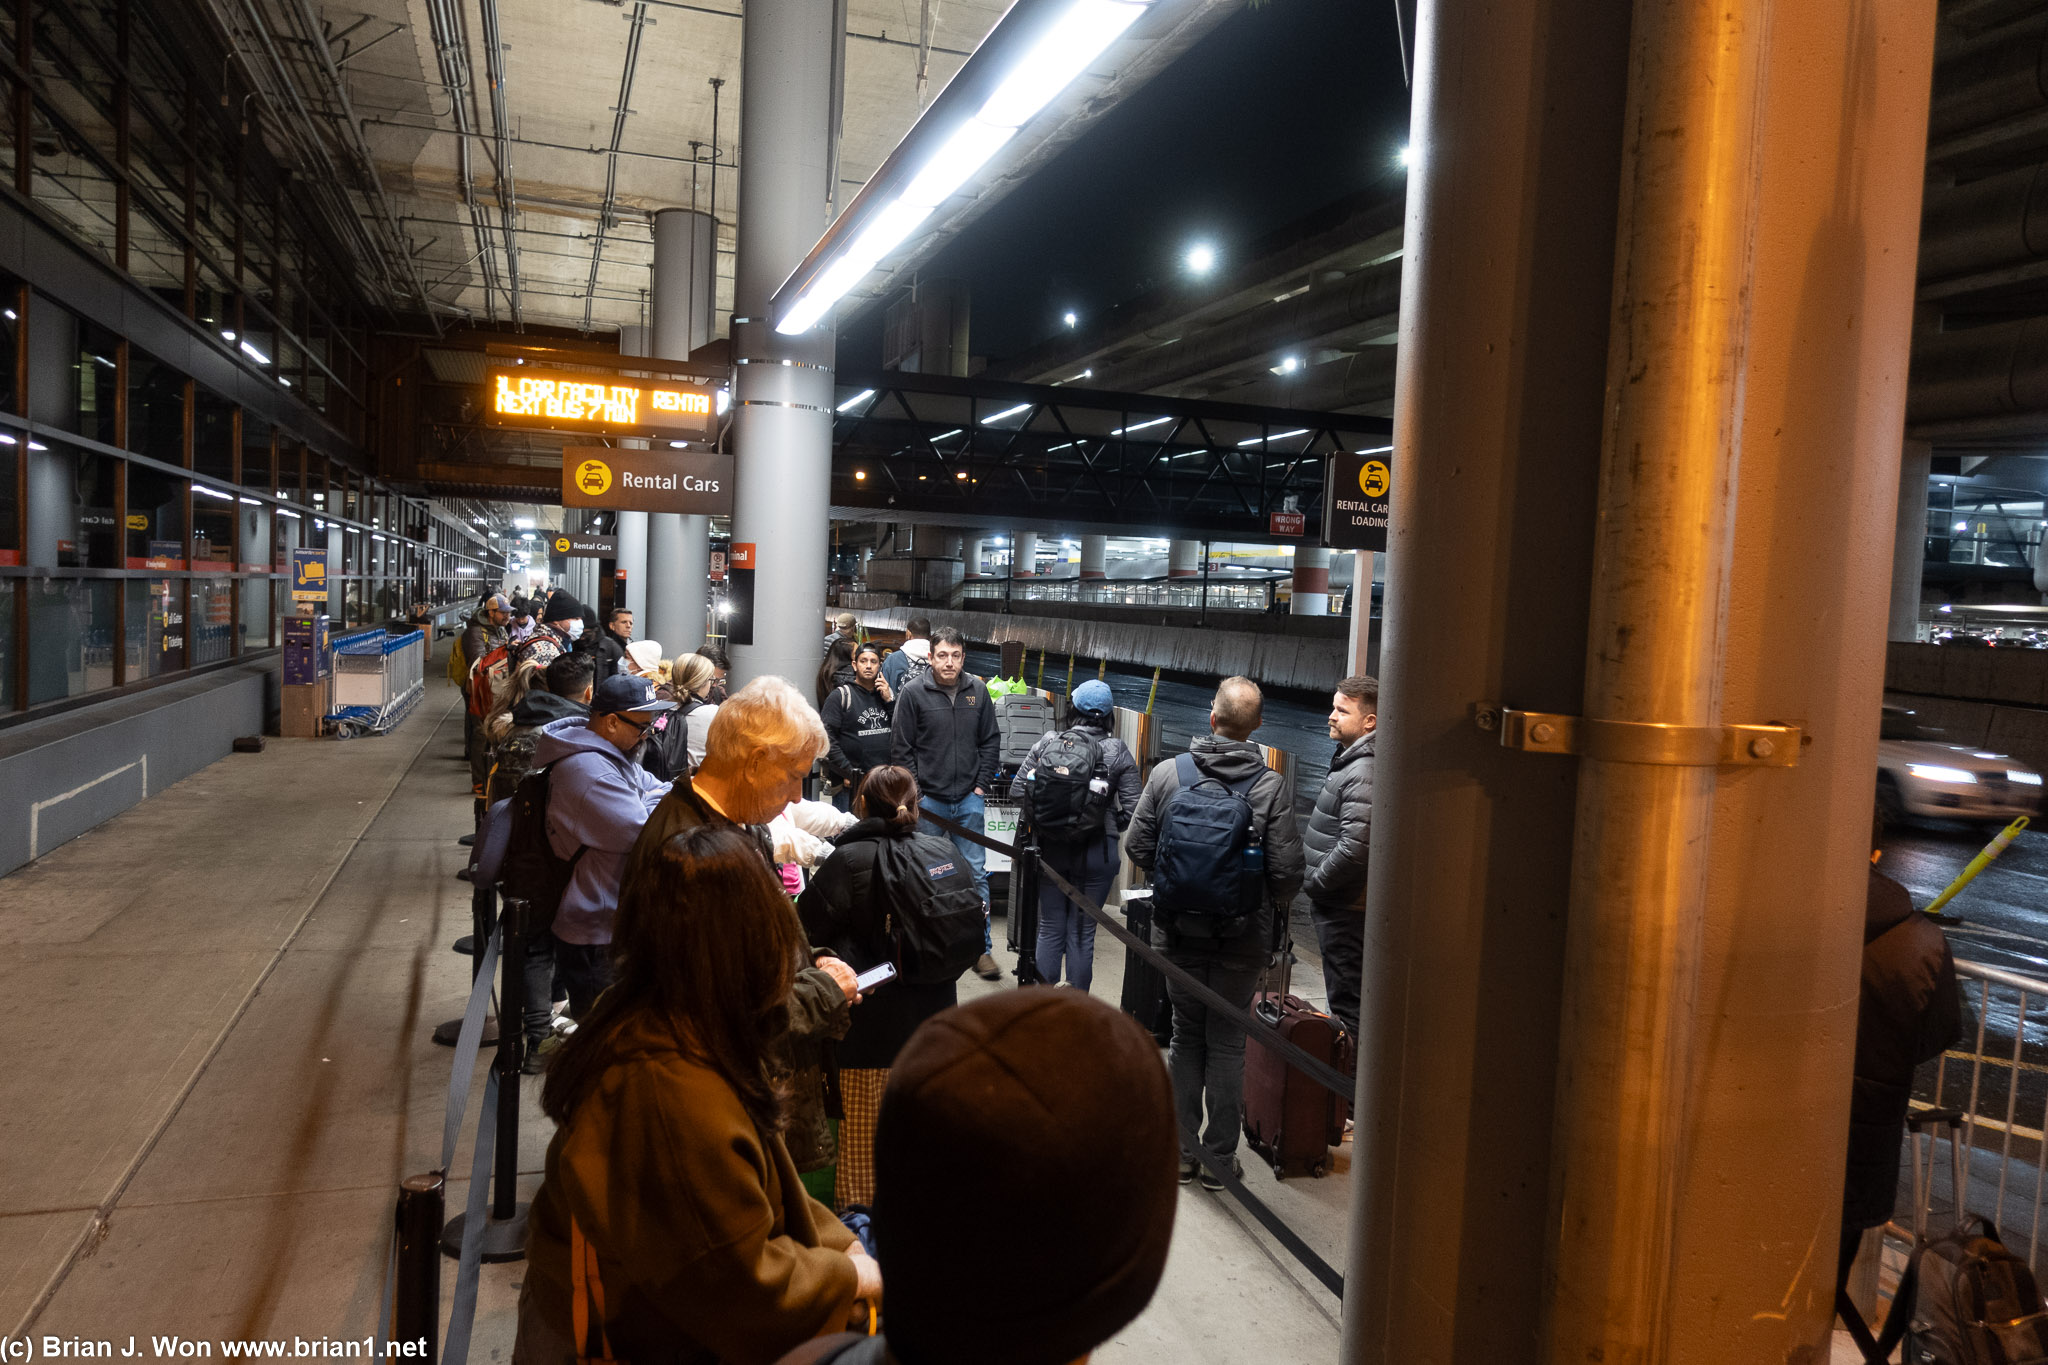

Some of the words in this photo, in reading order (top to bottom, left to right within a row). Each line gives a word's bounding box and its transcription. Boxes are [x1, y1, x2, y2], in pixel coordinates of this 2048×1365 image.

[519, 378, 555, 400] CAR
[558, 381, 639, 406] FACILITY
[495, 392, 540, 415] NEXT
[587, 403, 602, 420] 7
[604, 404, 637, 424] MIN
[623, 471, 677, 490] Rental
[683, 475, 720, 493] Cars
[1336, 499, 1370, 513] RENTAL
[1275, 515, 1301, 525] WRONG
[1279, 525, 1295, 533] WAY
[573, 541, 595, 550] Rental
[596, 543, 612, 551] Cars
[1211, 563, 1217, 571] 3
